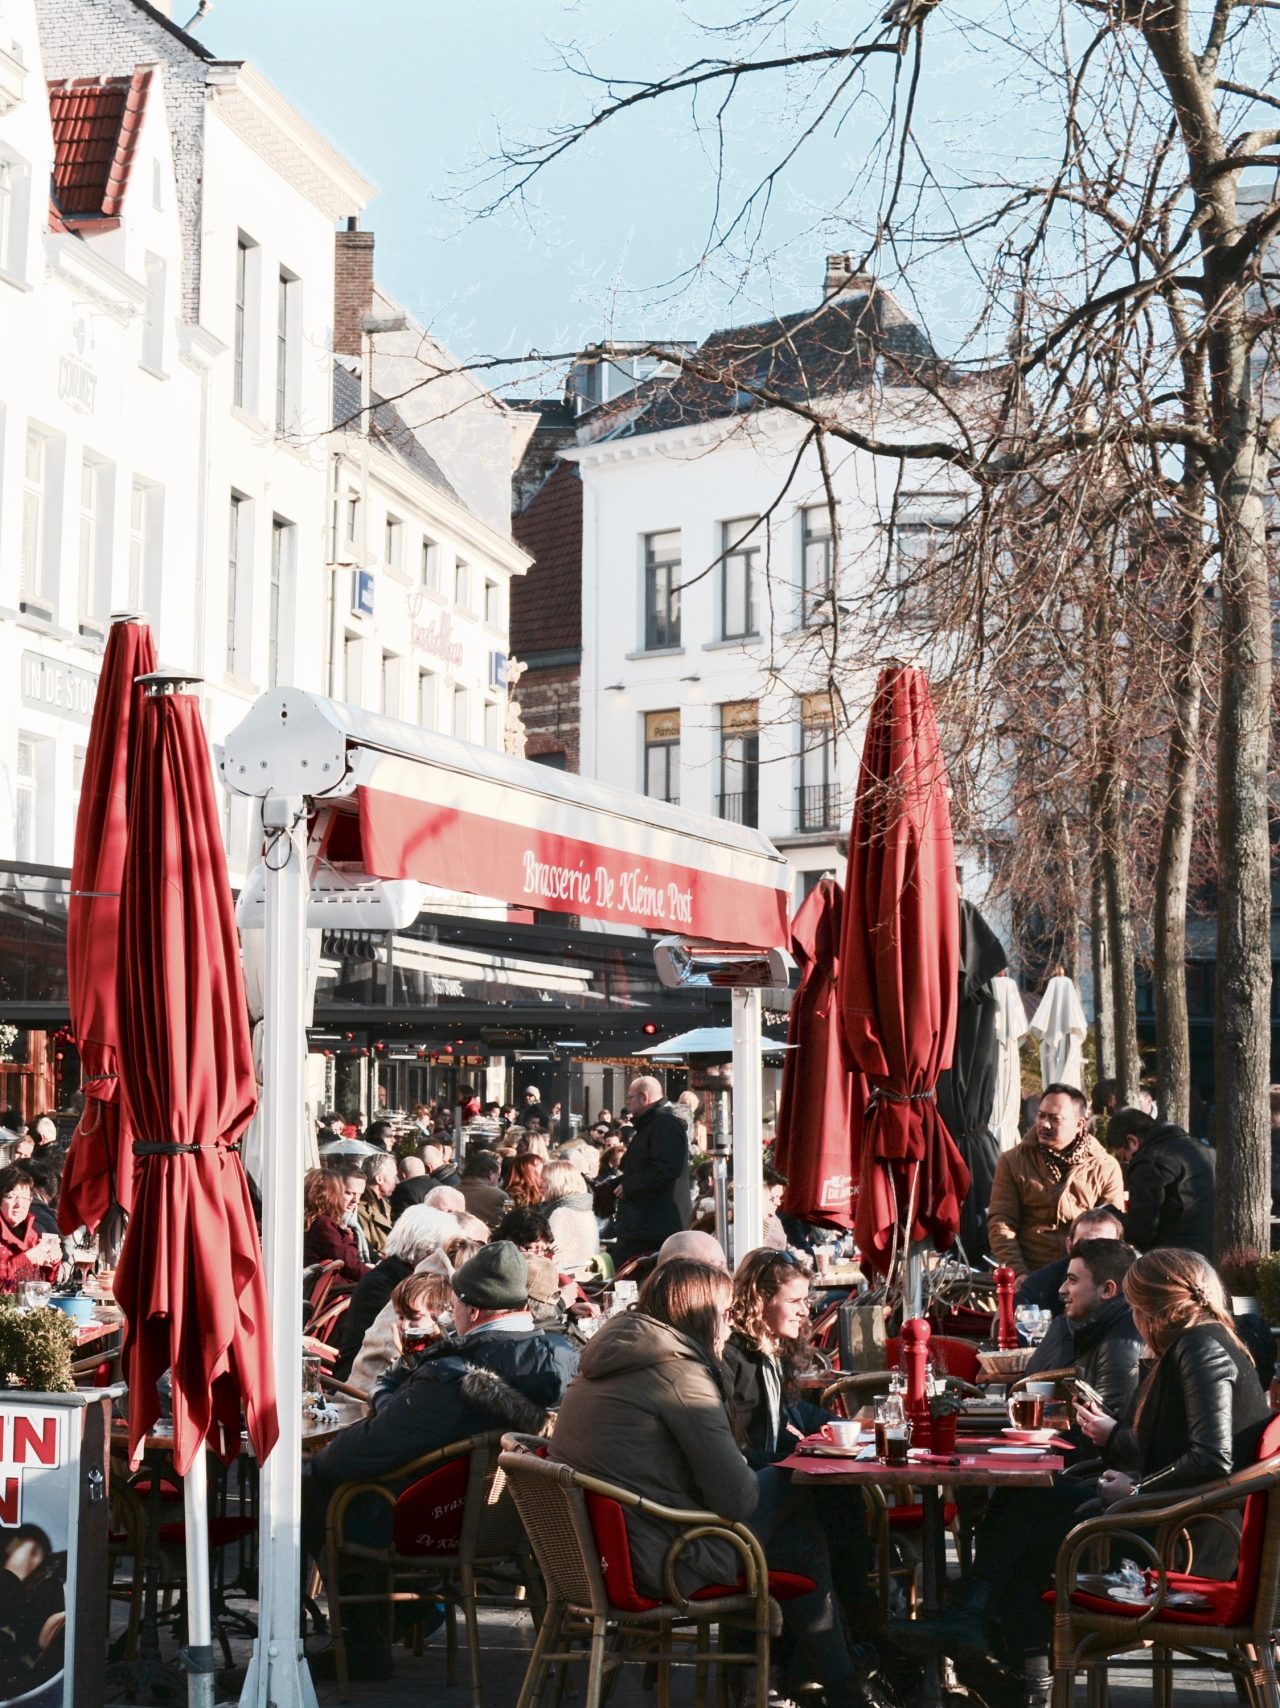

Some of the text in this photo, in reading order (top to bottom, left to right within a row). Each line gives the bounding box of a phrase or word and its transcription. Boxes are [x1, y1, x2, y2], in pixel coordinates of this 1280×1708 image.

[25, 660, 41, 700] IN
[46, 666, 62, 706] DE
[523, 850, 693, 923] Brasserie De Kleine Post
